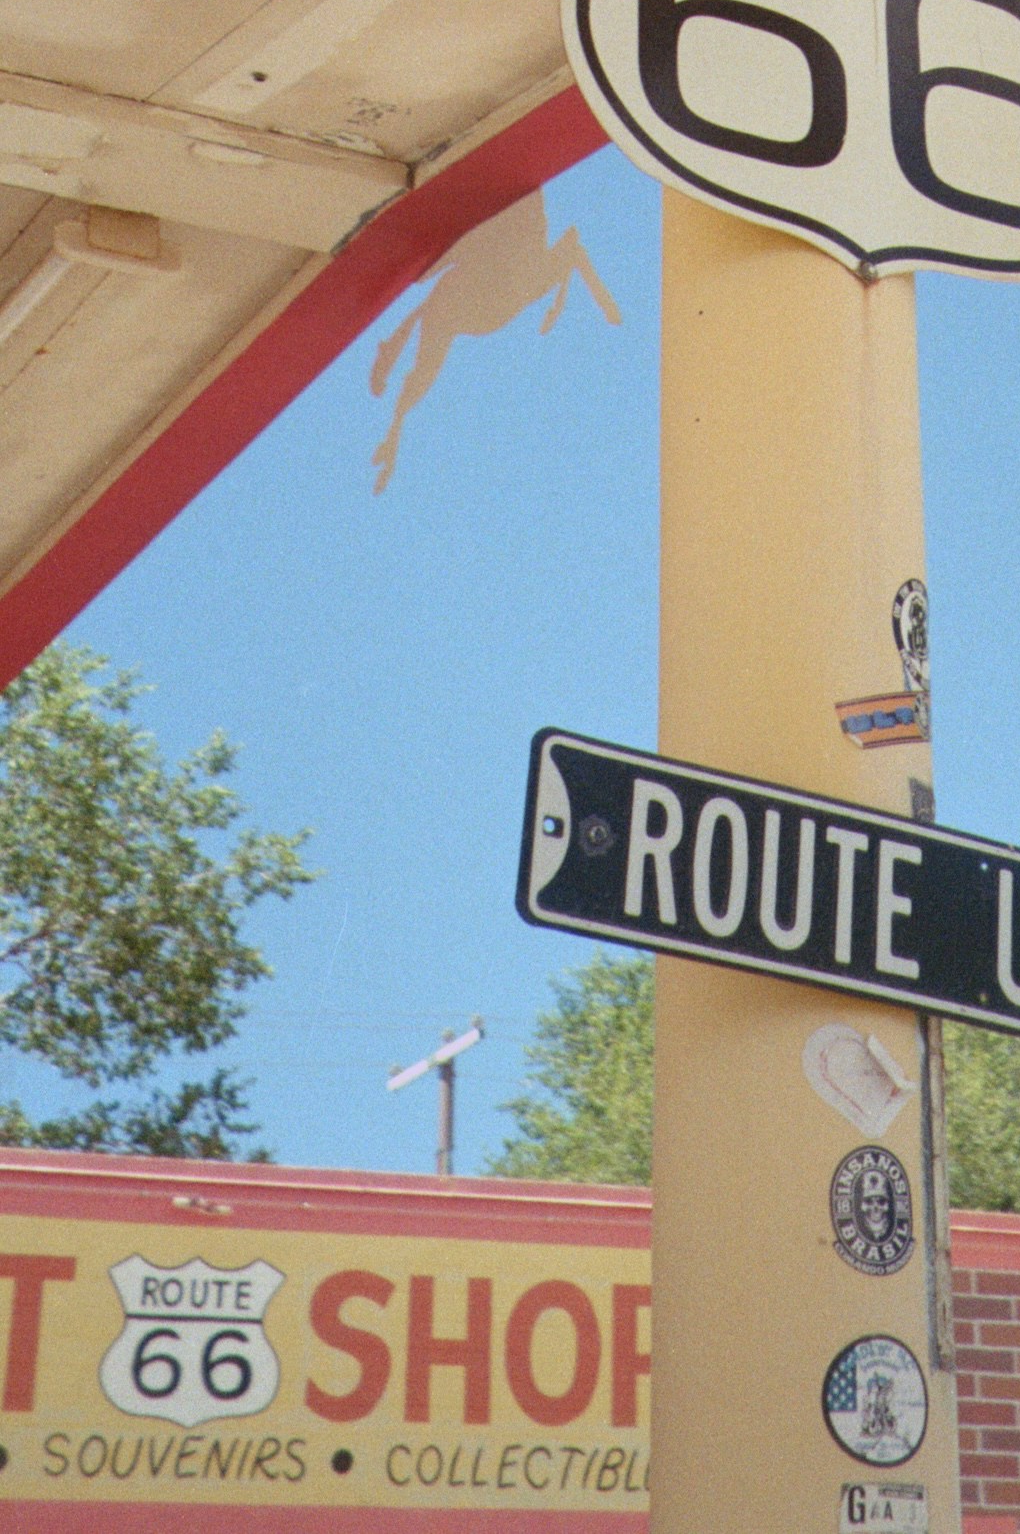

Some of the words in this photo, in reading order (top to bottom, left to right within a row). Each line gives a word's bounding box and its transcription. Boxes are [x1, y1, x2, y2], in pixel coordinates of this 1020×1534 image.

[623, 777, 923, 980] ROUTE
[836, 1152, 907, 1195] INSANOS
[841, 1223, 909, 1261] BRASIL
[140, 1275, 252, 1311] ROUTE
[132, 1327, 253, 1400] 66
[43, 1431, 307, 1481] SOUVENIRS
[386, 1442, 651, 1492] COLLECTIBL
